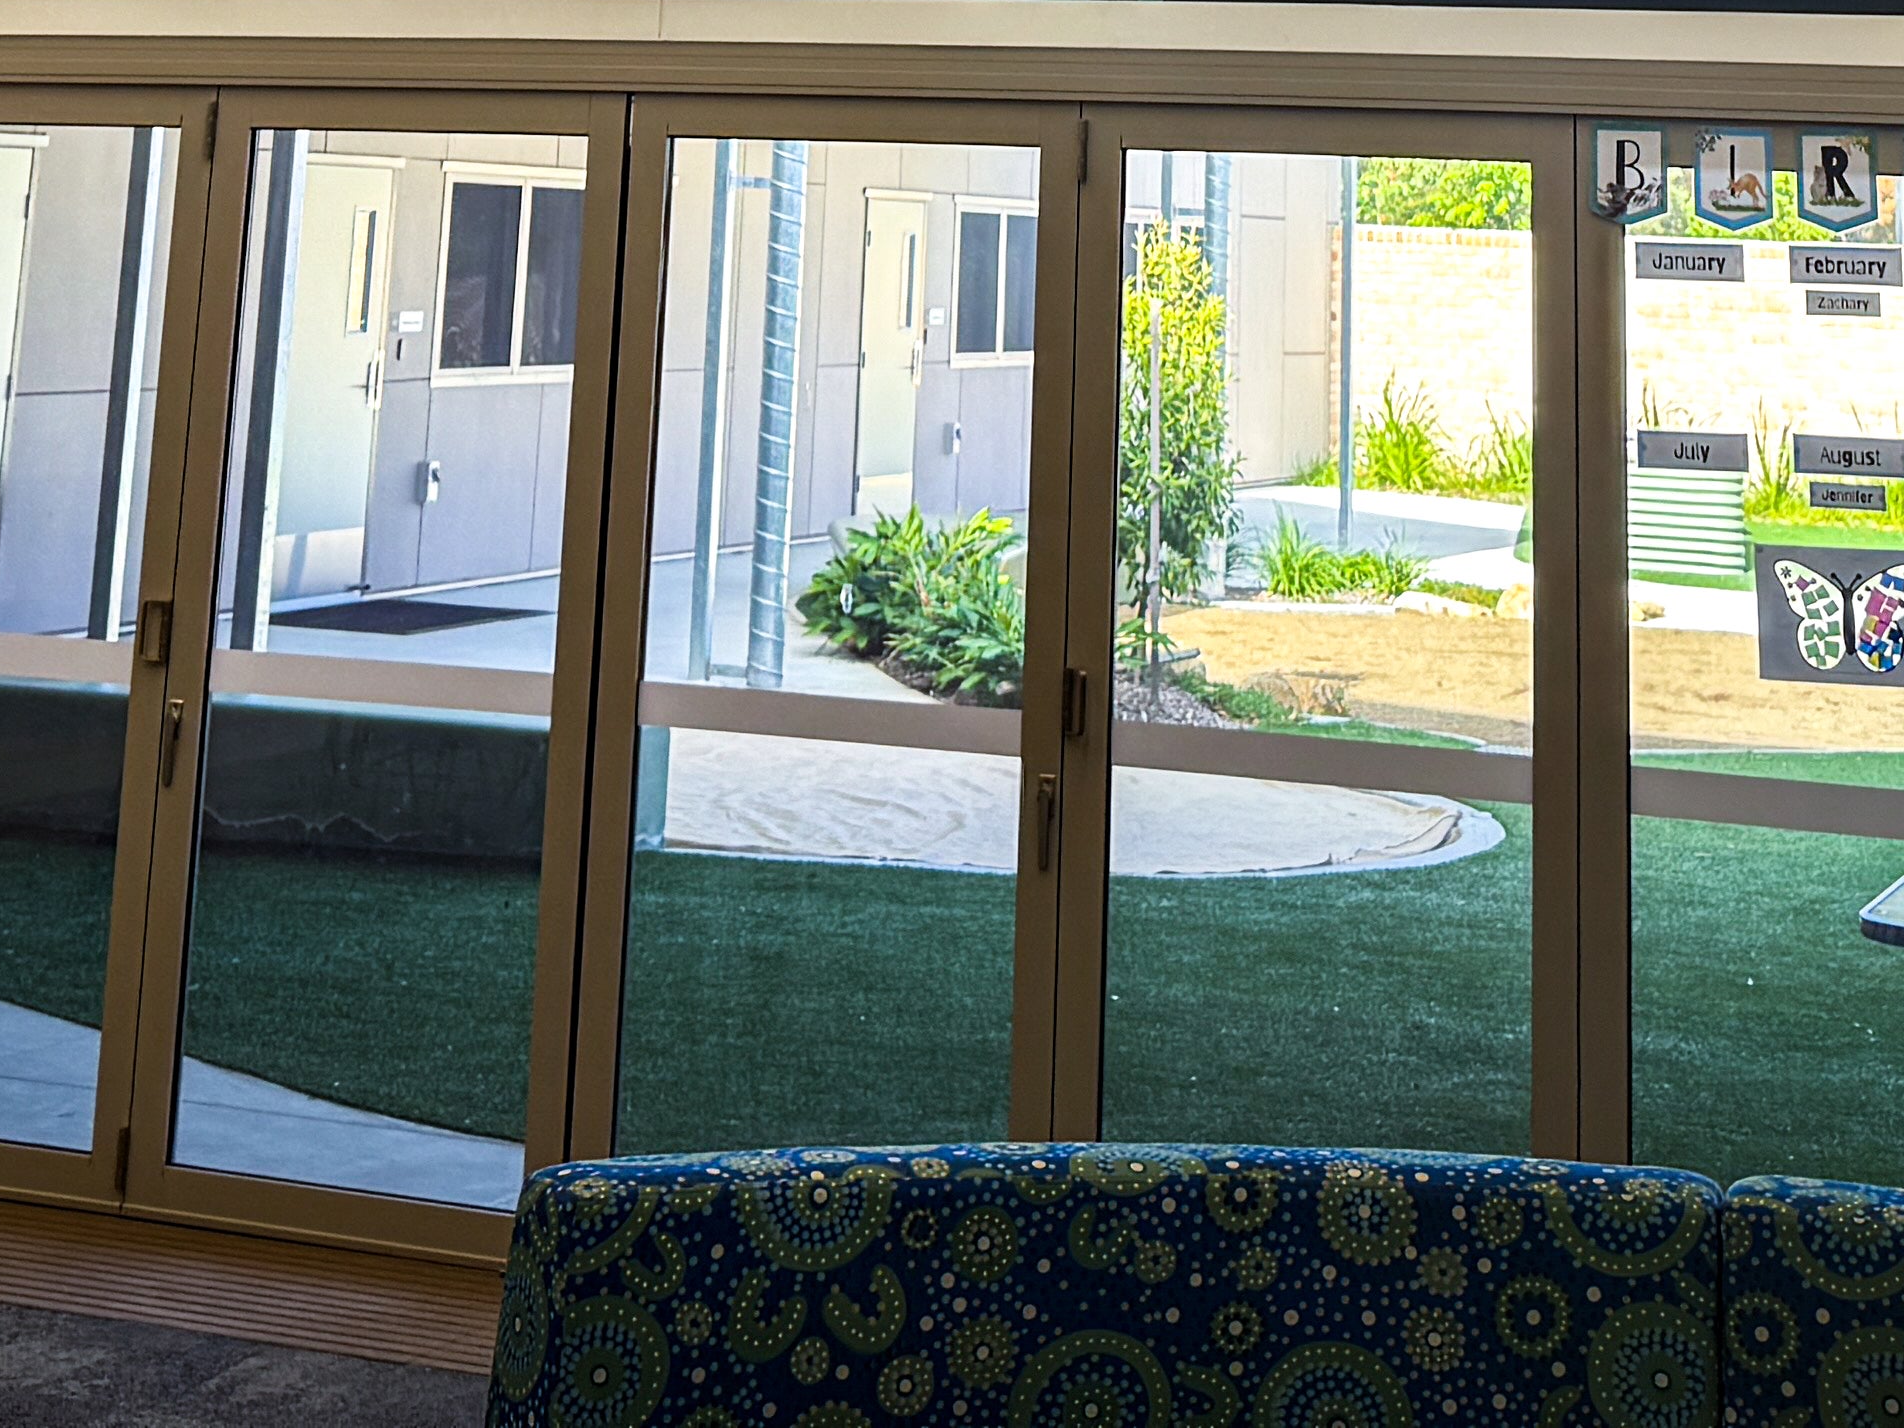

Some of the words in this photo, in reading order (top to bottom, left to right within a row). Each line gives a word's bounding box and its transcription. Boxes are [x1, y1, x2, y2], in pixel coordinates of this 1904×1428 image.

[1652, 251, 1726, 275] January
[1805, 255, 1887, 279] February
[1818, 296, 1869, 312] Zachary
[1674, 441, 1710, 465] July
[1820, 447, 1882, 469] August
[1822, 489, 1873, 503] Jennifer
